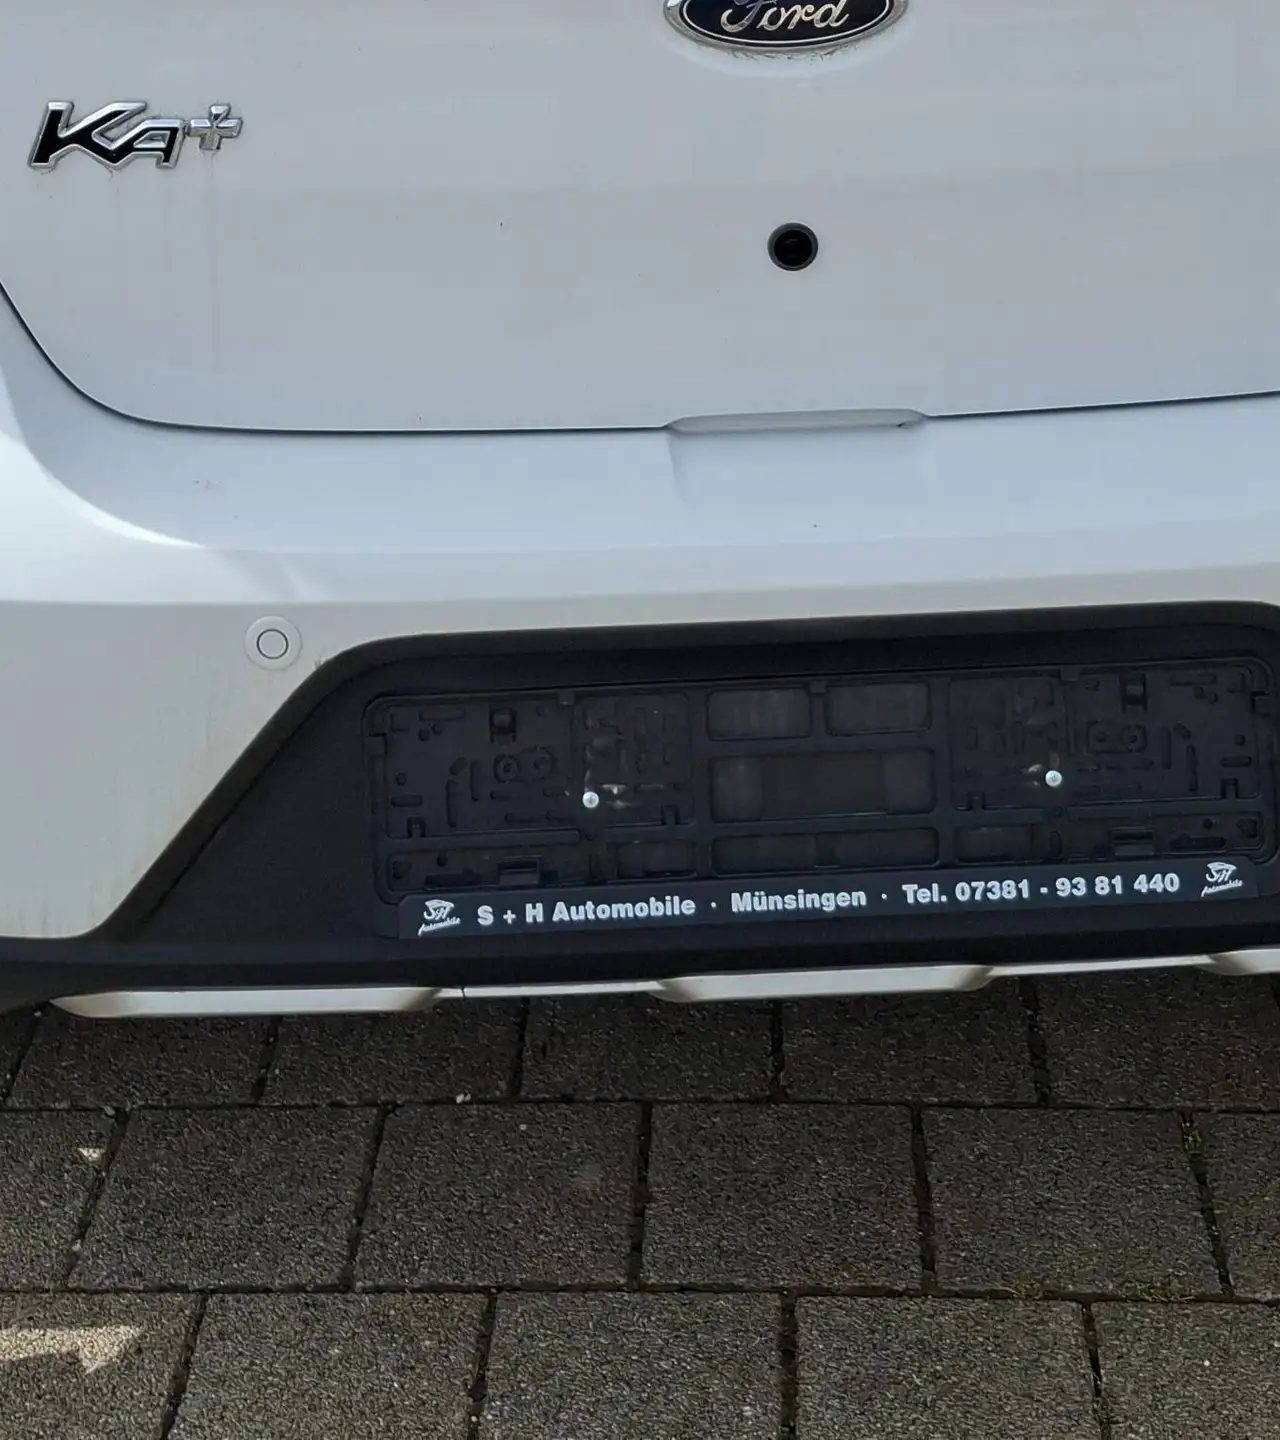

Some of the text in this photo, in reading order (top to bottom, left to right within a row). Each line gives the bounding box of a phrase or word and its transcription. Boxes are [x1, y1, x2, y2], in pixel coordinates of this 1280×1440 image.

[477, 904, 495, 926] S
[502, 909, 516, 924] +
[524, 903, 544, 923] H
[552, 895, 697, 922] Automobile
[731, 887, 867, 913] Münsingen
[902, 882, 948, 905] Tel.
[955, 878, 1030, 902] 07381
[1055, 876, 1087, 898] 93
[1094, 874, 1123, 896] 81
[1133, 872, 1180, 894] 440
